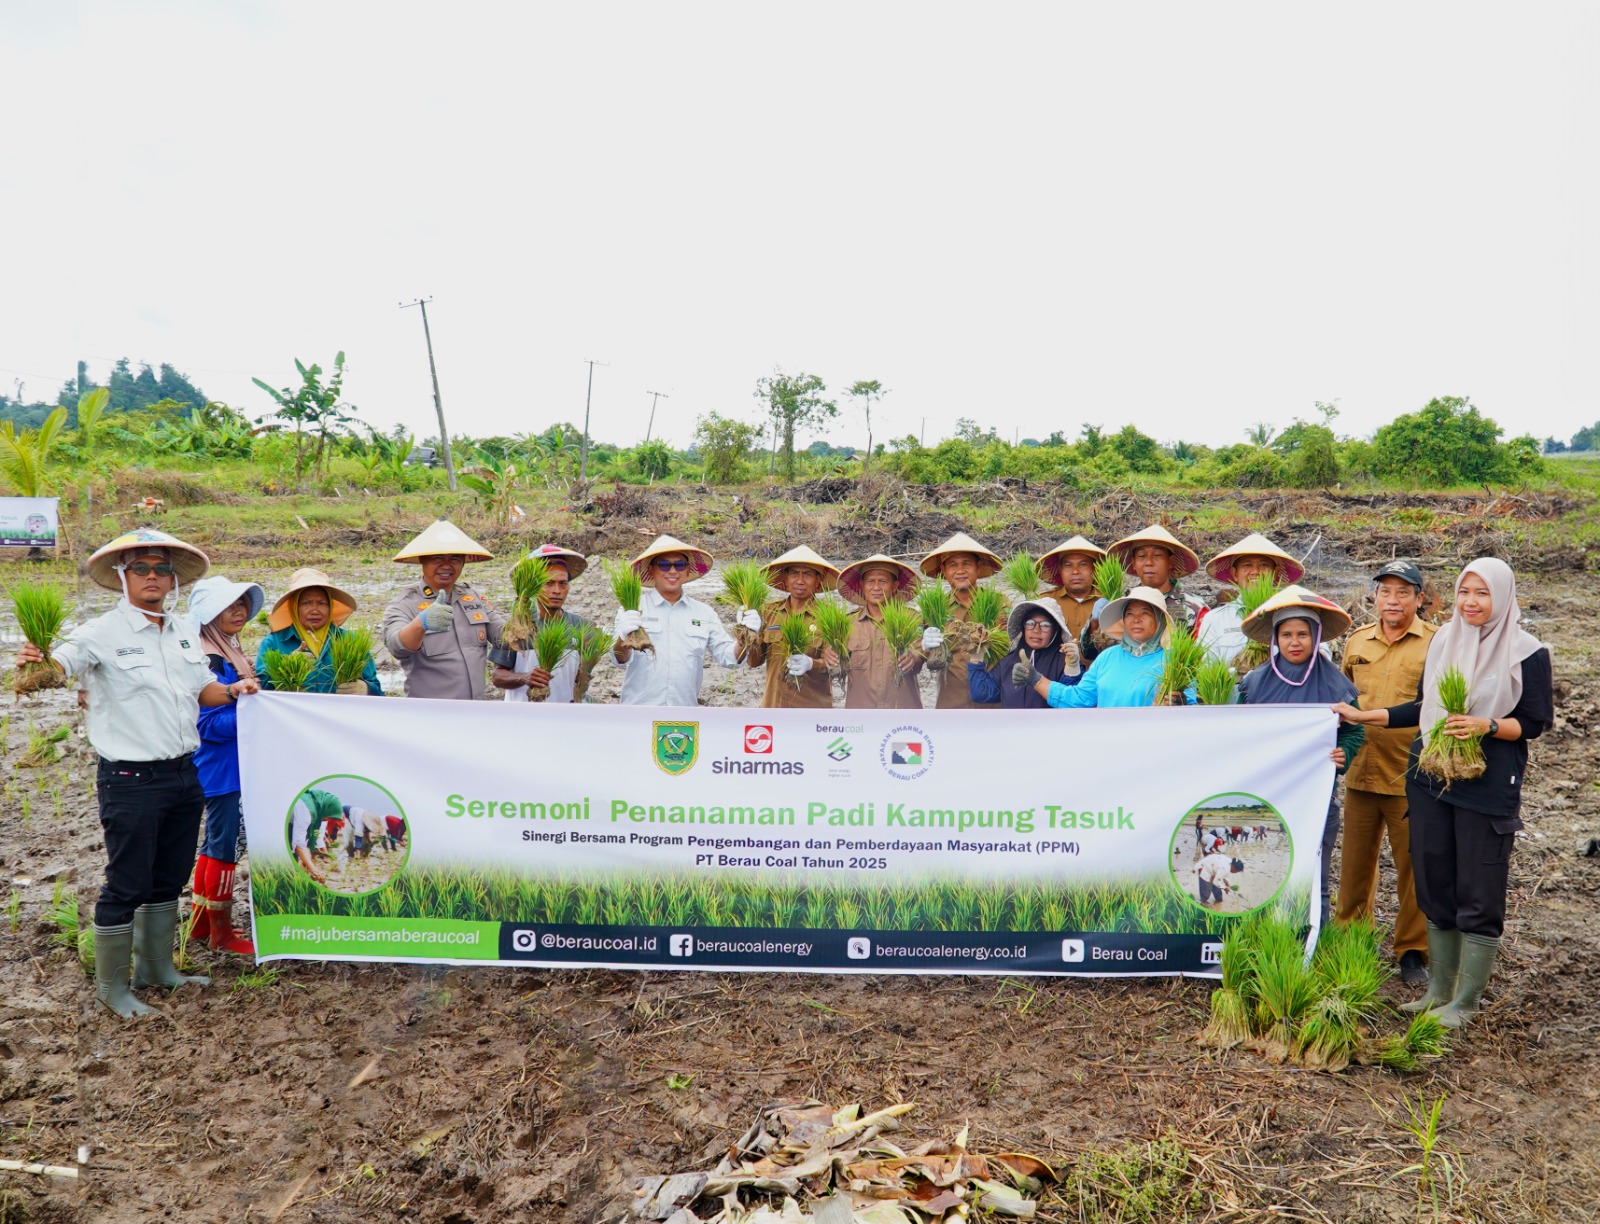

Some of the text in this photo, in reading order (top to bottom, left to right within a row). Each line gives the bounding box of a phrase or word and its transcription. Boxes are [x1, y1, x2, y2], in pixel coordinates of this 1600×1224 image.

[879, 733, 892, 767] YAYASAN
[891, 725, 923, 736] DHARMA
[711, 757, 805, 776] sinarmas
[888, 766, 929, 781] BERAU COAL
[445, 794, 1136, 833] Seremoni Penanaman Padi Kampung Tasuk
[522, 830, 1080, 856] Sinergi Bersama Program Pengembangan dan Pemberdayaan Masyarakat (PPM)
[695, 854, 887, 869] PT Berau Coal Tahun 2025
[280, 925, 480, 945] #majubersamaberaucoal
[541, 933, 657, 951] @beraucoal.id
[697, 939, 813, 956] beraucoalenergy
[876, 944, 1027, 960] beraucoalenergy.co.id
[1092, 946, 1168, 961] Berau Coal
